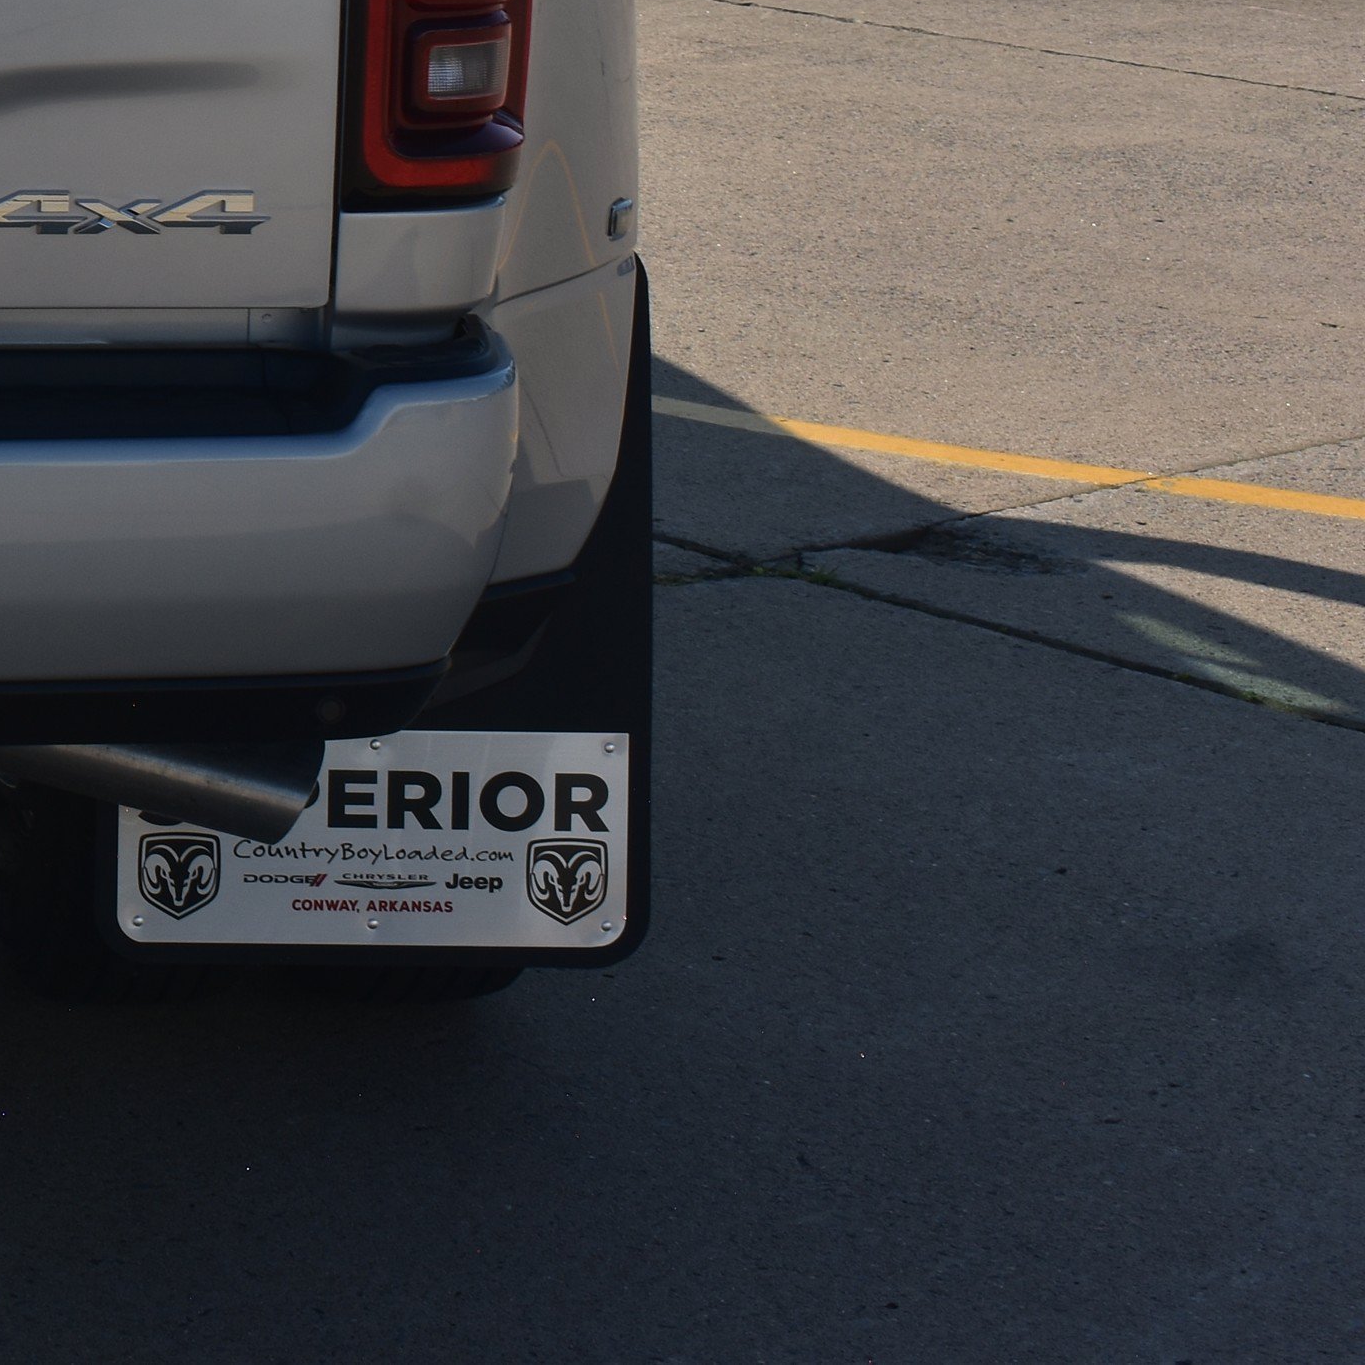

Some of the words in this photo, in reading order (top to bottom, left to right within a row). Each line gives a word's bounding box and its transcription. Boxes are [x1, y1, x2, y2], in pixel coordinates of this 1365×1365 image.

[138, 769, 610, 833] ERIOR
[233, 839, 515, 865] CountryBoyLoaded.com
[243, 873, 318, 884] DODGE
[342, 872, 429, 881] CHRYSLER
[445, 873, 504, 893] Jeep
[292, 899, 360, 913] CONWAY,
[366, 900, 453, 913] ARKANSAS
